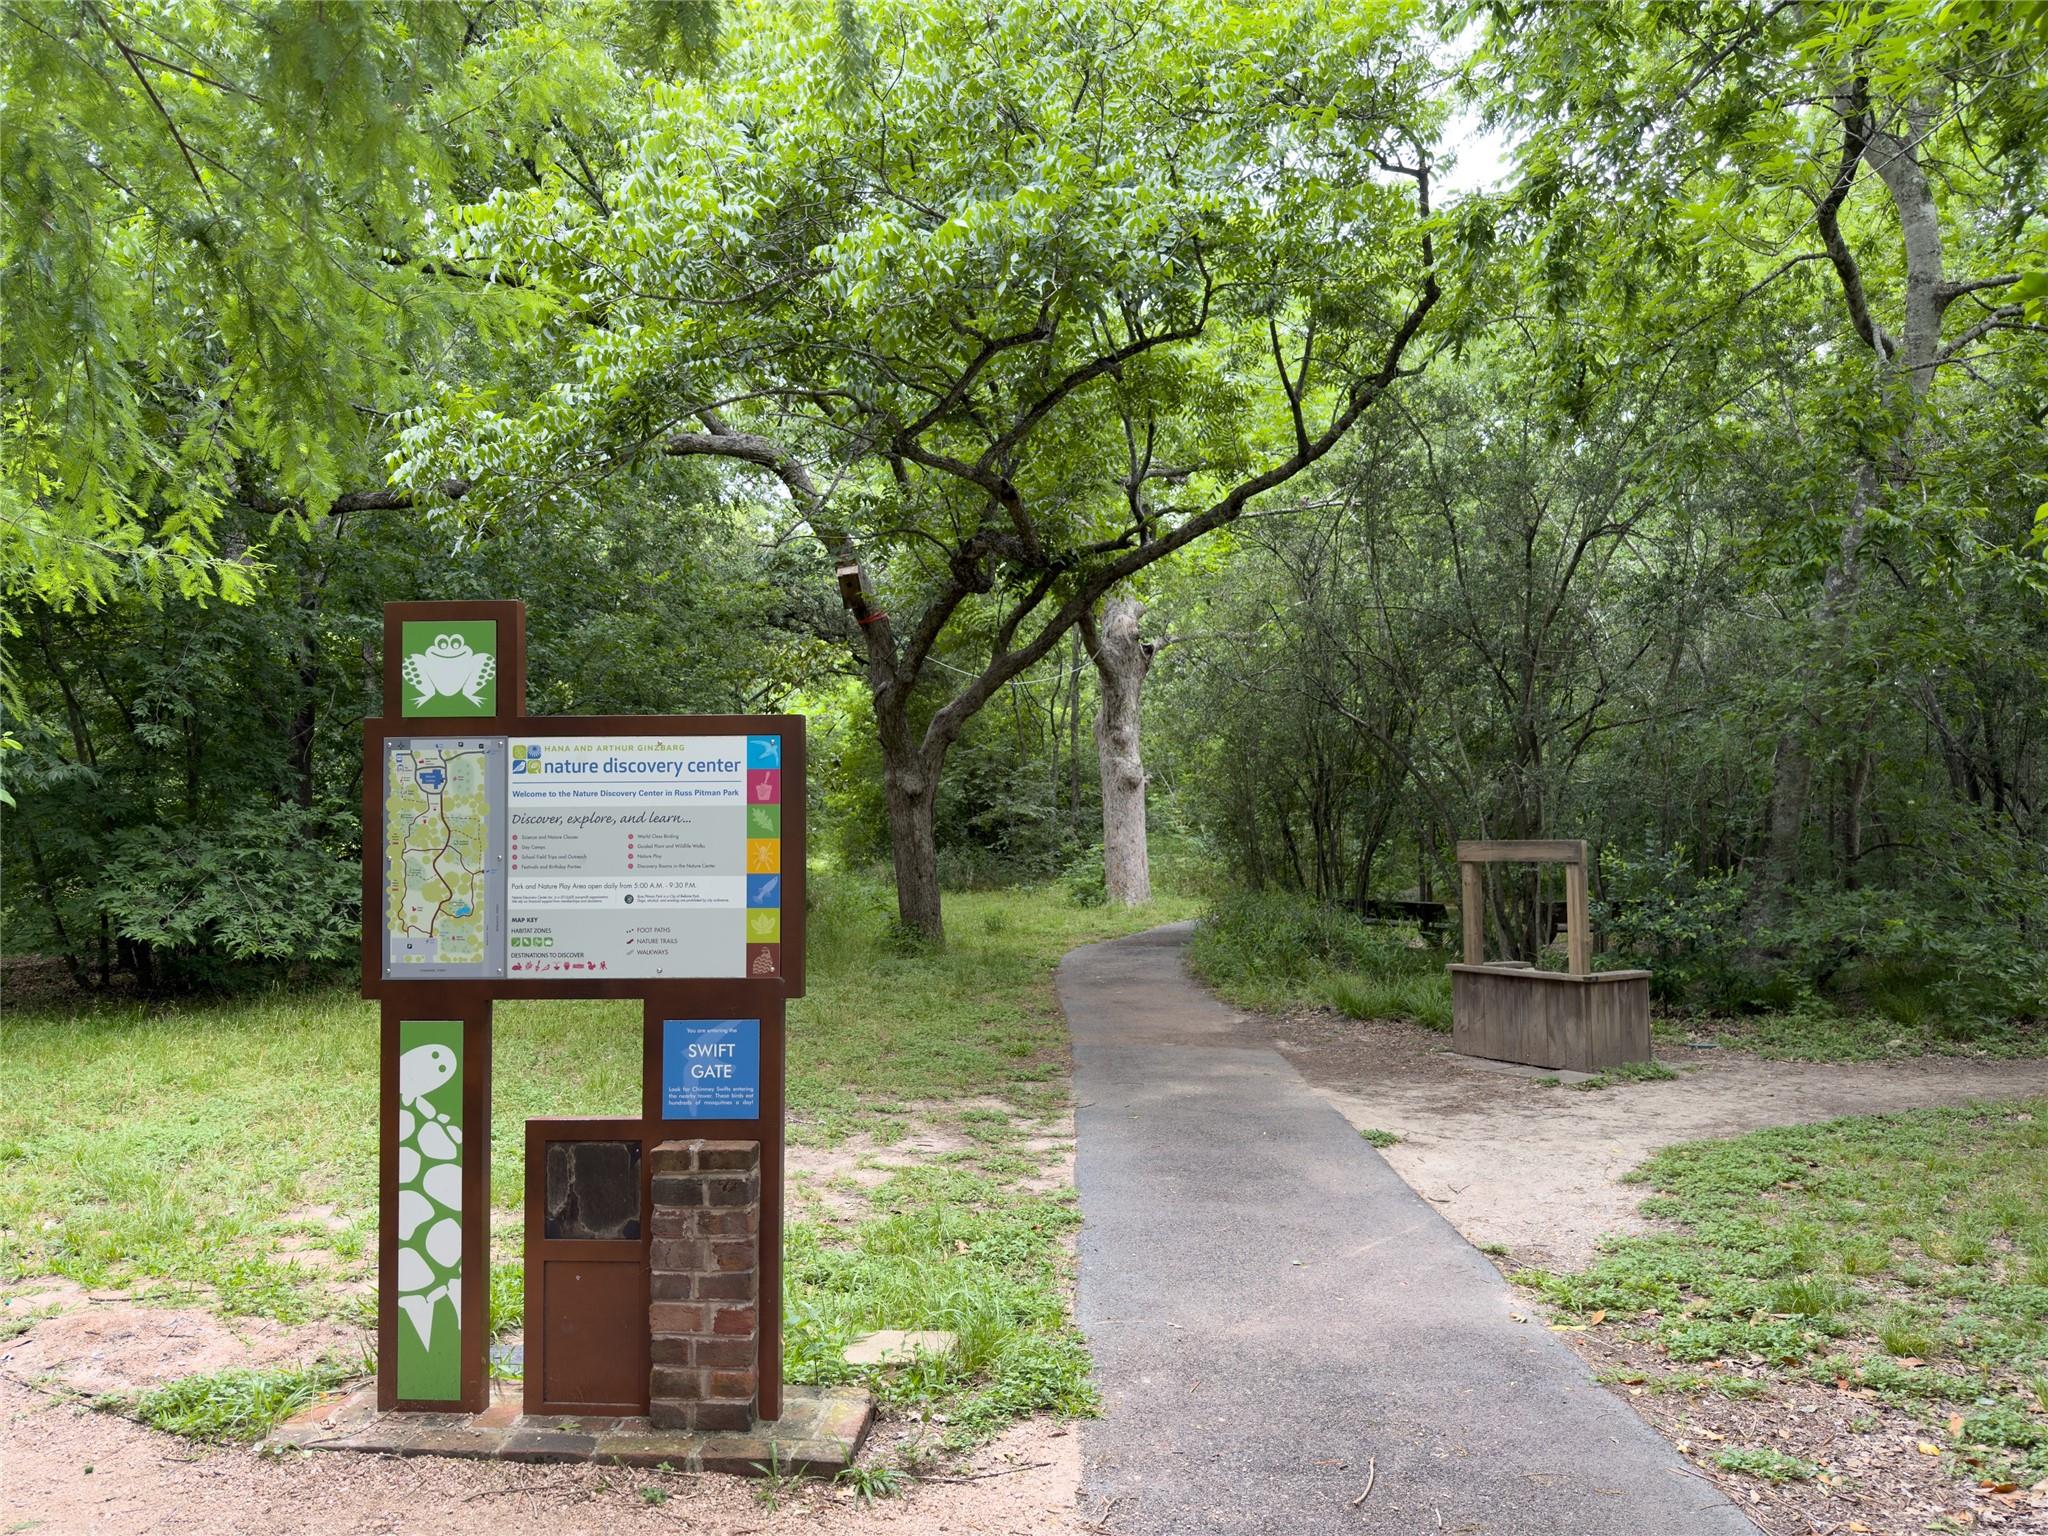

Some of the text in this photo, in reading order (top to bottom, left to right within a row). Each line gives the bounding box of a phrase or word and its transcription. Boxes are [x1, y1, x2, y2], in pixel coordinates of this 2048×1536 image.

[545, 757, 741, 777] nature discovery center
[600, 790, 636, 798] Discovery
[512, 811, 691, 828] Discover, explore, and learn...
[688, 1044, 735, 1058] SWIFT
[691, 1064, 732, 1078] GATE
